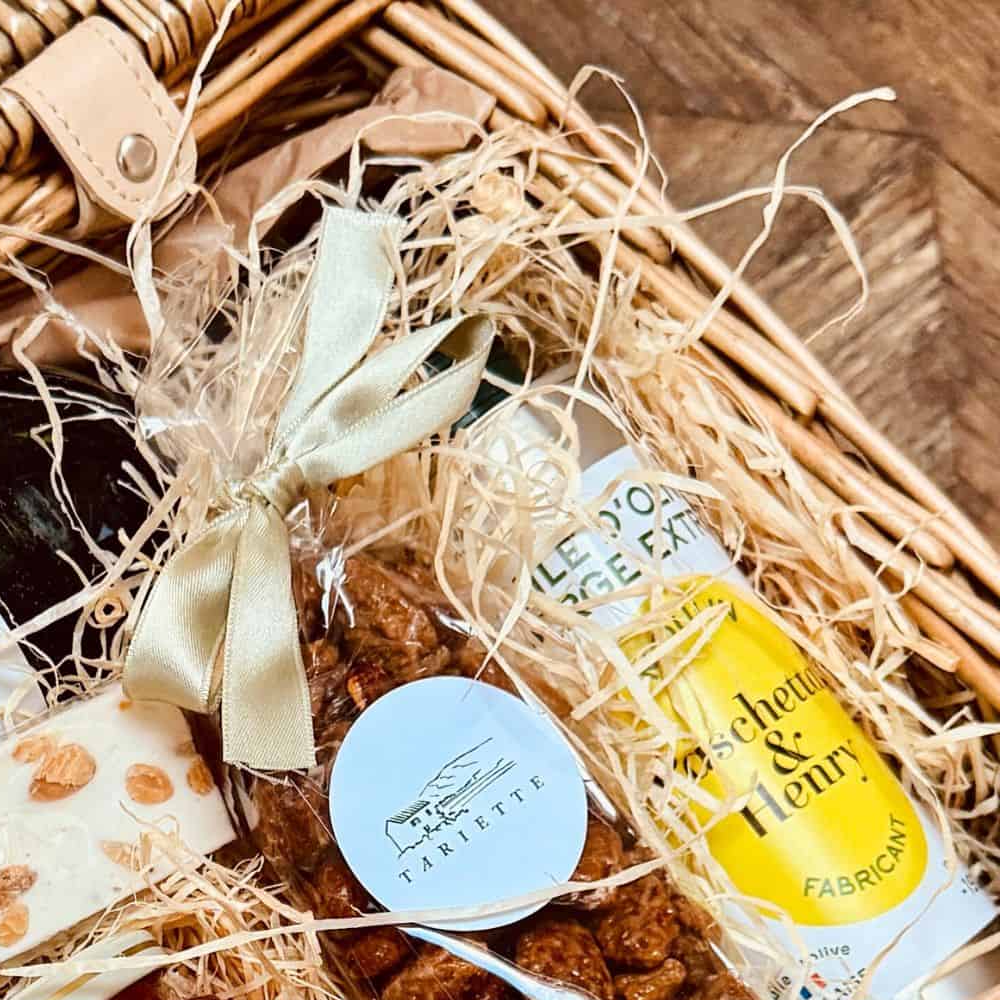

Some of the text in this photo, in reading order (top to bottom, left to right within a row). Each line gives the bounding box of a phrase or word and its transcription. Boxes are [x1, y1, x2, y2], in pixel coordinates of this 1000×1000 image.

[739, 739, 868, 839] Henry
[764, 730, 816, 776] &
[398, 774, 546, 886] TARIETTE
[803, 813, 908, 898] FABRICANT
